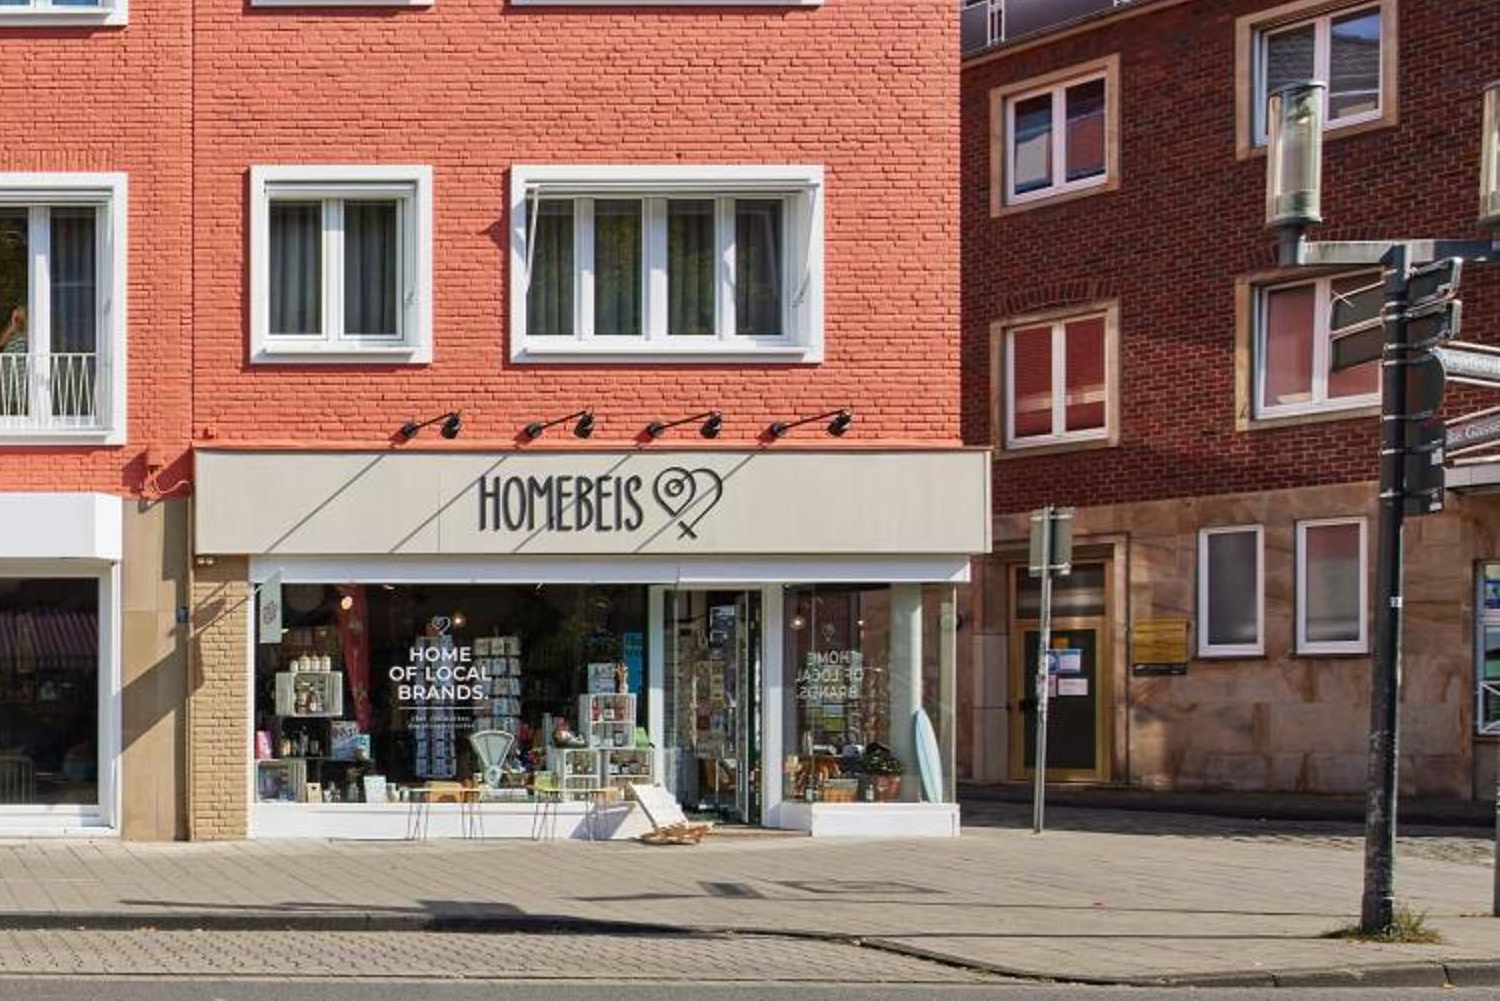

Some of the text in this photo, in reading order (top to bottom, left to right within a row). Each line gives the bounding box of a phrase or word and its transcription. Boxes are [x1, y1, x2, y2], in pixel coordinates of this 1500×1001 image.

[478, 474, 644, 532] HOMEBEIS
[409, 646, 472, 662] HOME
[389, 666, 492, 681] OF LOCAL
[398, 684, 489, 700] BRANDS.
